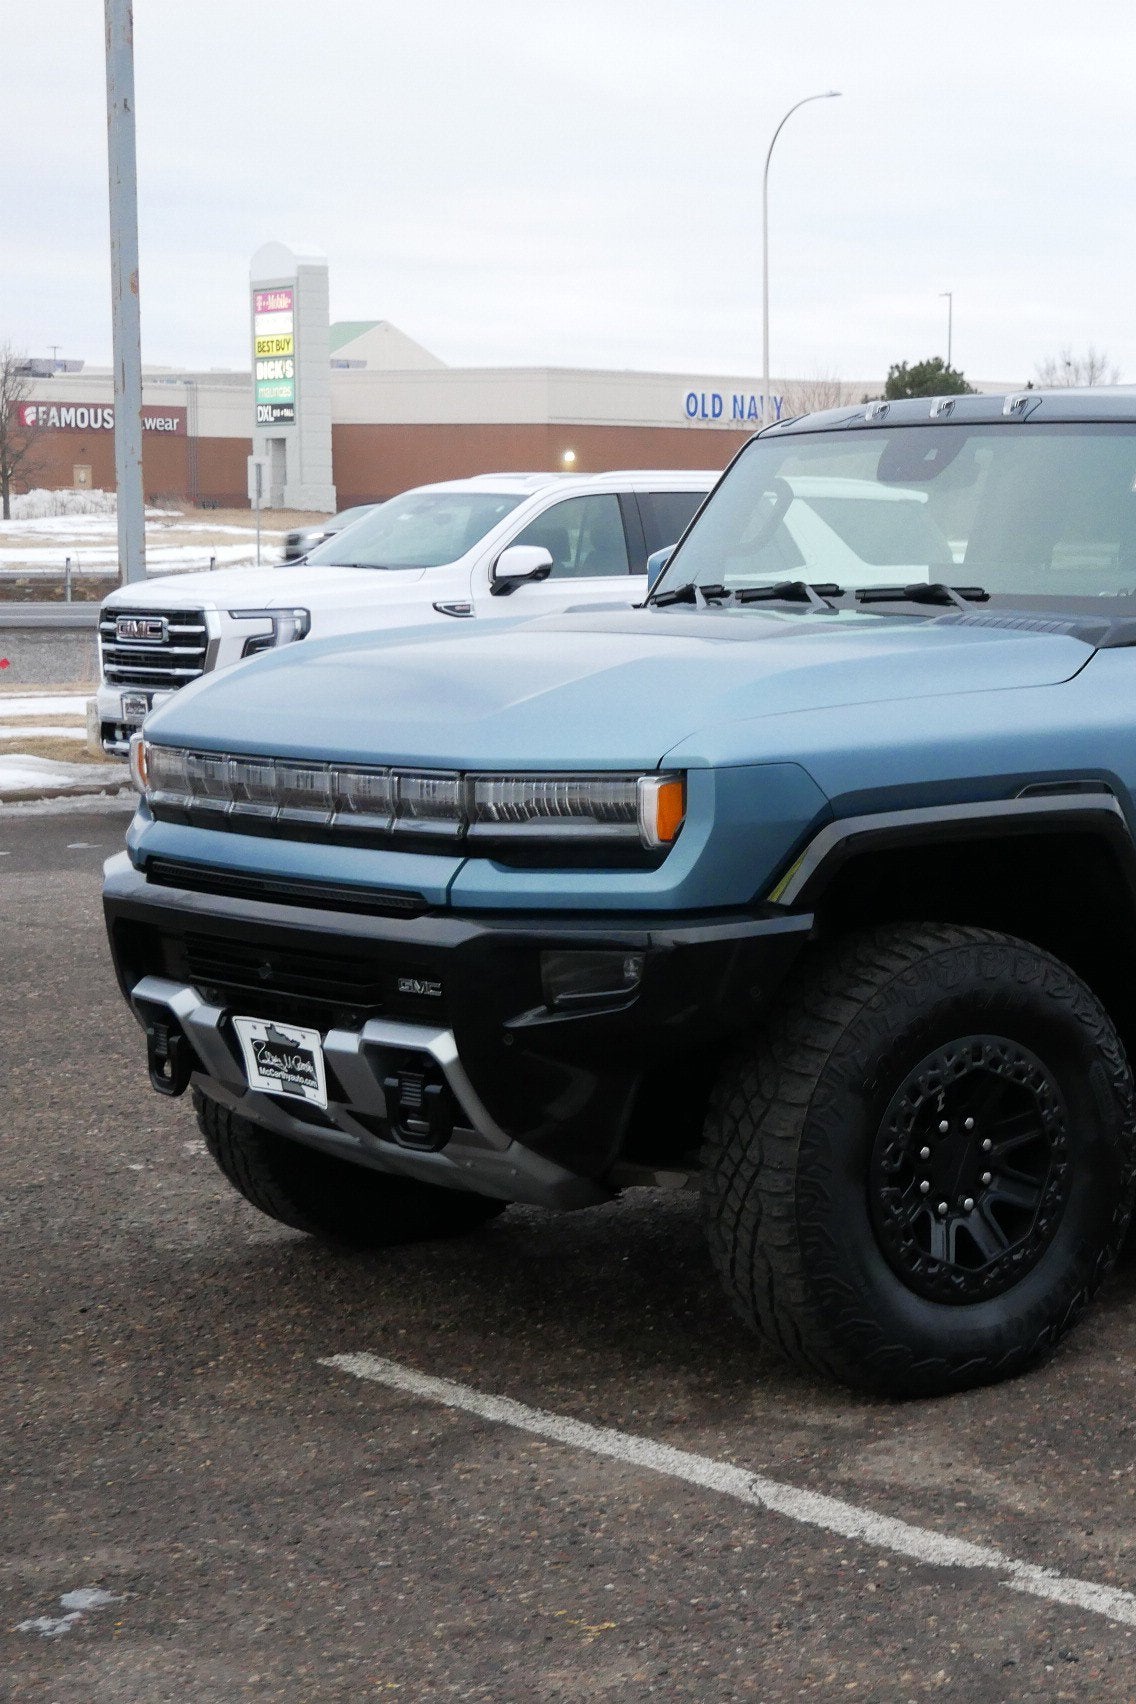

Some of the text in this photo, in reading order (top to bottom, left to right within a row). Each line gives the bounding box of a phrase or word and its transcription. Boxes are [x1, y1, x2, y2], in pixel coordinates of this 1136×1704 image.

[257, 338, 291, 353] BEST BUY
[256, 360, 294, 380] DICK'S
[257, 405, 274, 422] DXL
[686, 392, 724, 418] OLD
[38, 405, 114, 429] FAMOUS
[115, 620, 163, 639] GMC
[398, 977, 442, 997] GMC
